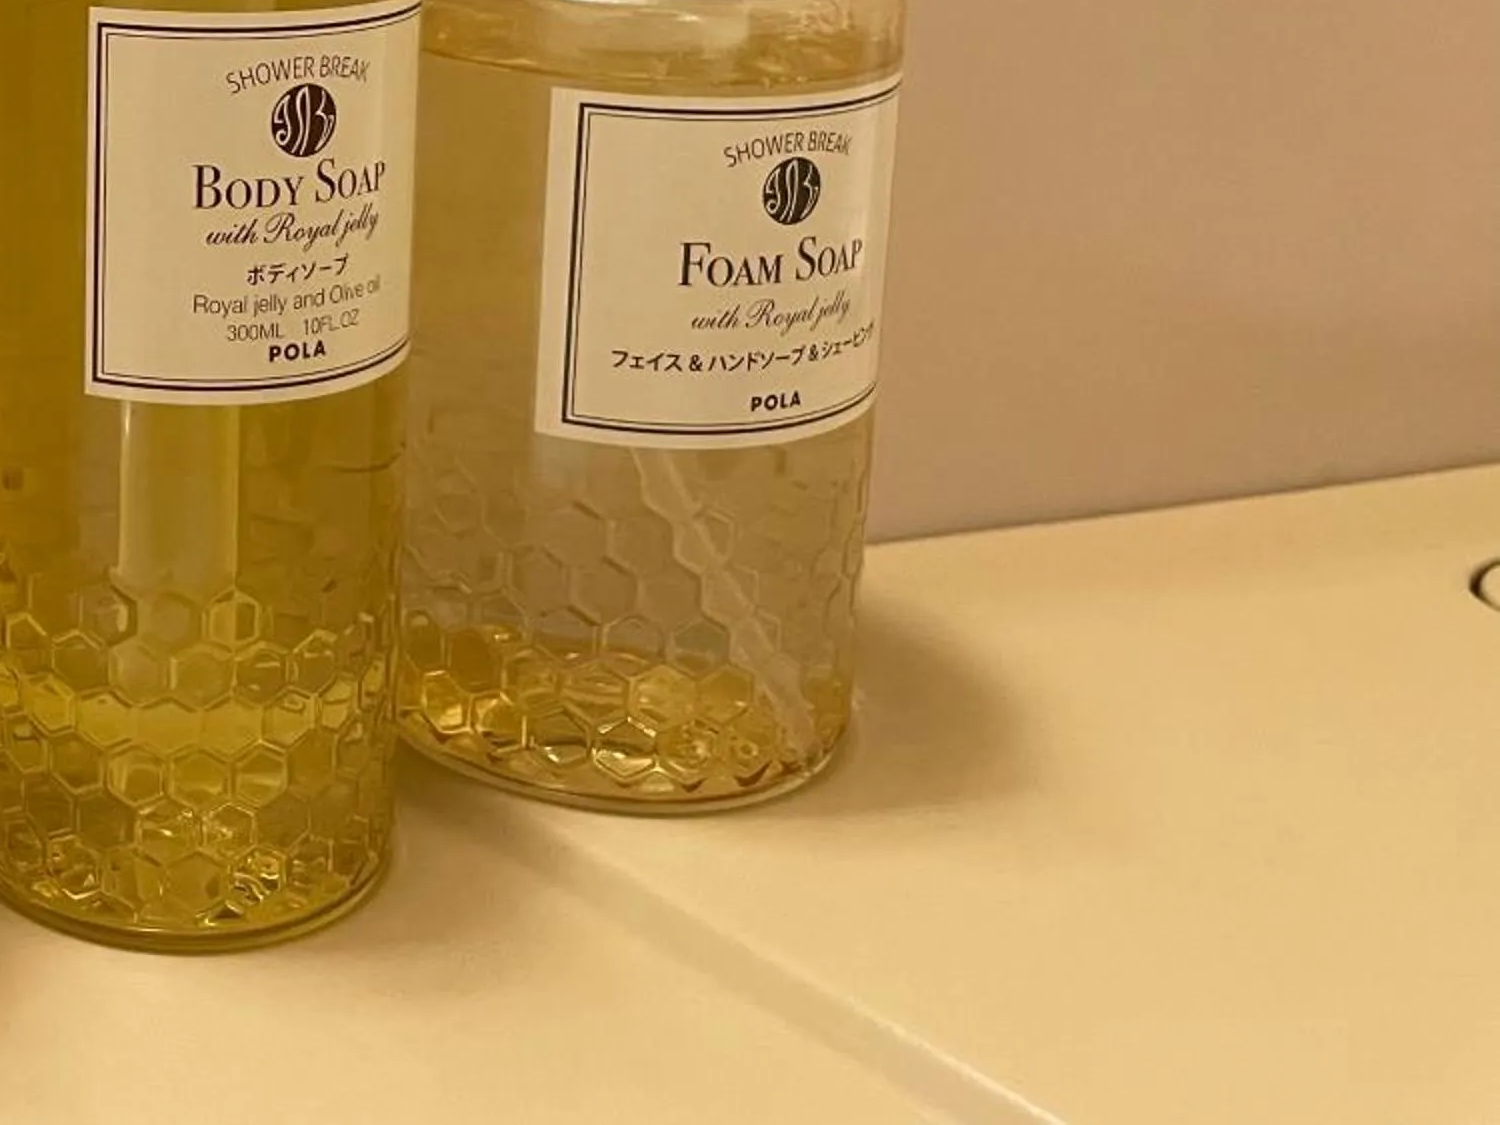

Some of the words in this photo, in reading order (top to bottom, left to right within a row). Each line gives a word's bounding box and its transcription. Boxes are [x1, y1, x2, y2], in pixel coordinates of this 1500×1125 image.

[226, 56, 314, 95] SHOWER
[319, 55, 370, 83] BREAK
[724, 131, 805, 168] SHOWER
[807, 130, 852, 156] BREAK
[192, 164, 305, 210] BODY
[315, 158, 387, 204] SOAP
[206, 219, 259, 245] with
[263, 212, 341, 251] Royal
[335, 202, 380, 248] jelly
[247, 253, 349, 286] ボディソープ
[678, 242, 783, 287] FOAM
[795, 236, 863, 281] SOAP
[193, 294, 247, 318] Royal
[253, 294, 288, 317] jelly
[293, 288, 325, 310] and
[329, 282, 365, 303] Olive
[691, 306, 740, 330] with
[745, 299, 816, 336] Royal
[809, 289, 851, 330] jelly
[227, 323, 284, 341] 300ML
[269, 340, 326, 362] POLA
[751, 390, 801, 412] POLA
